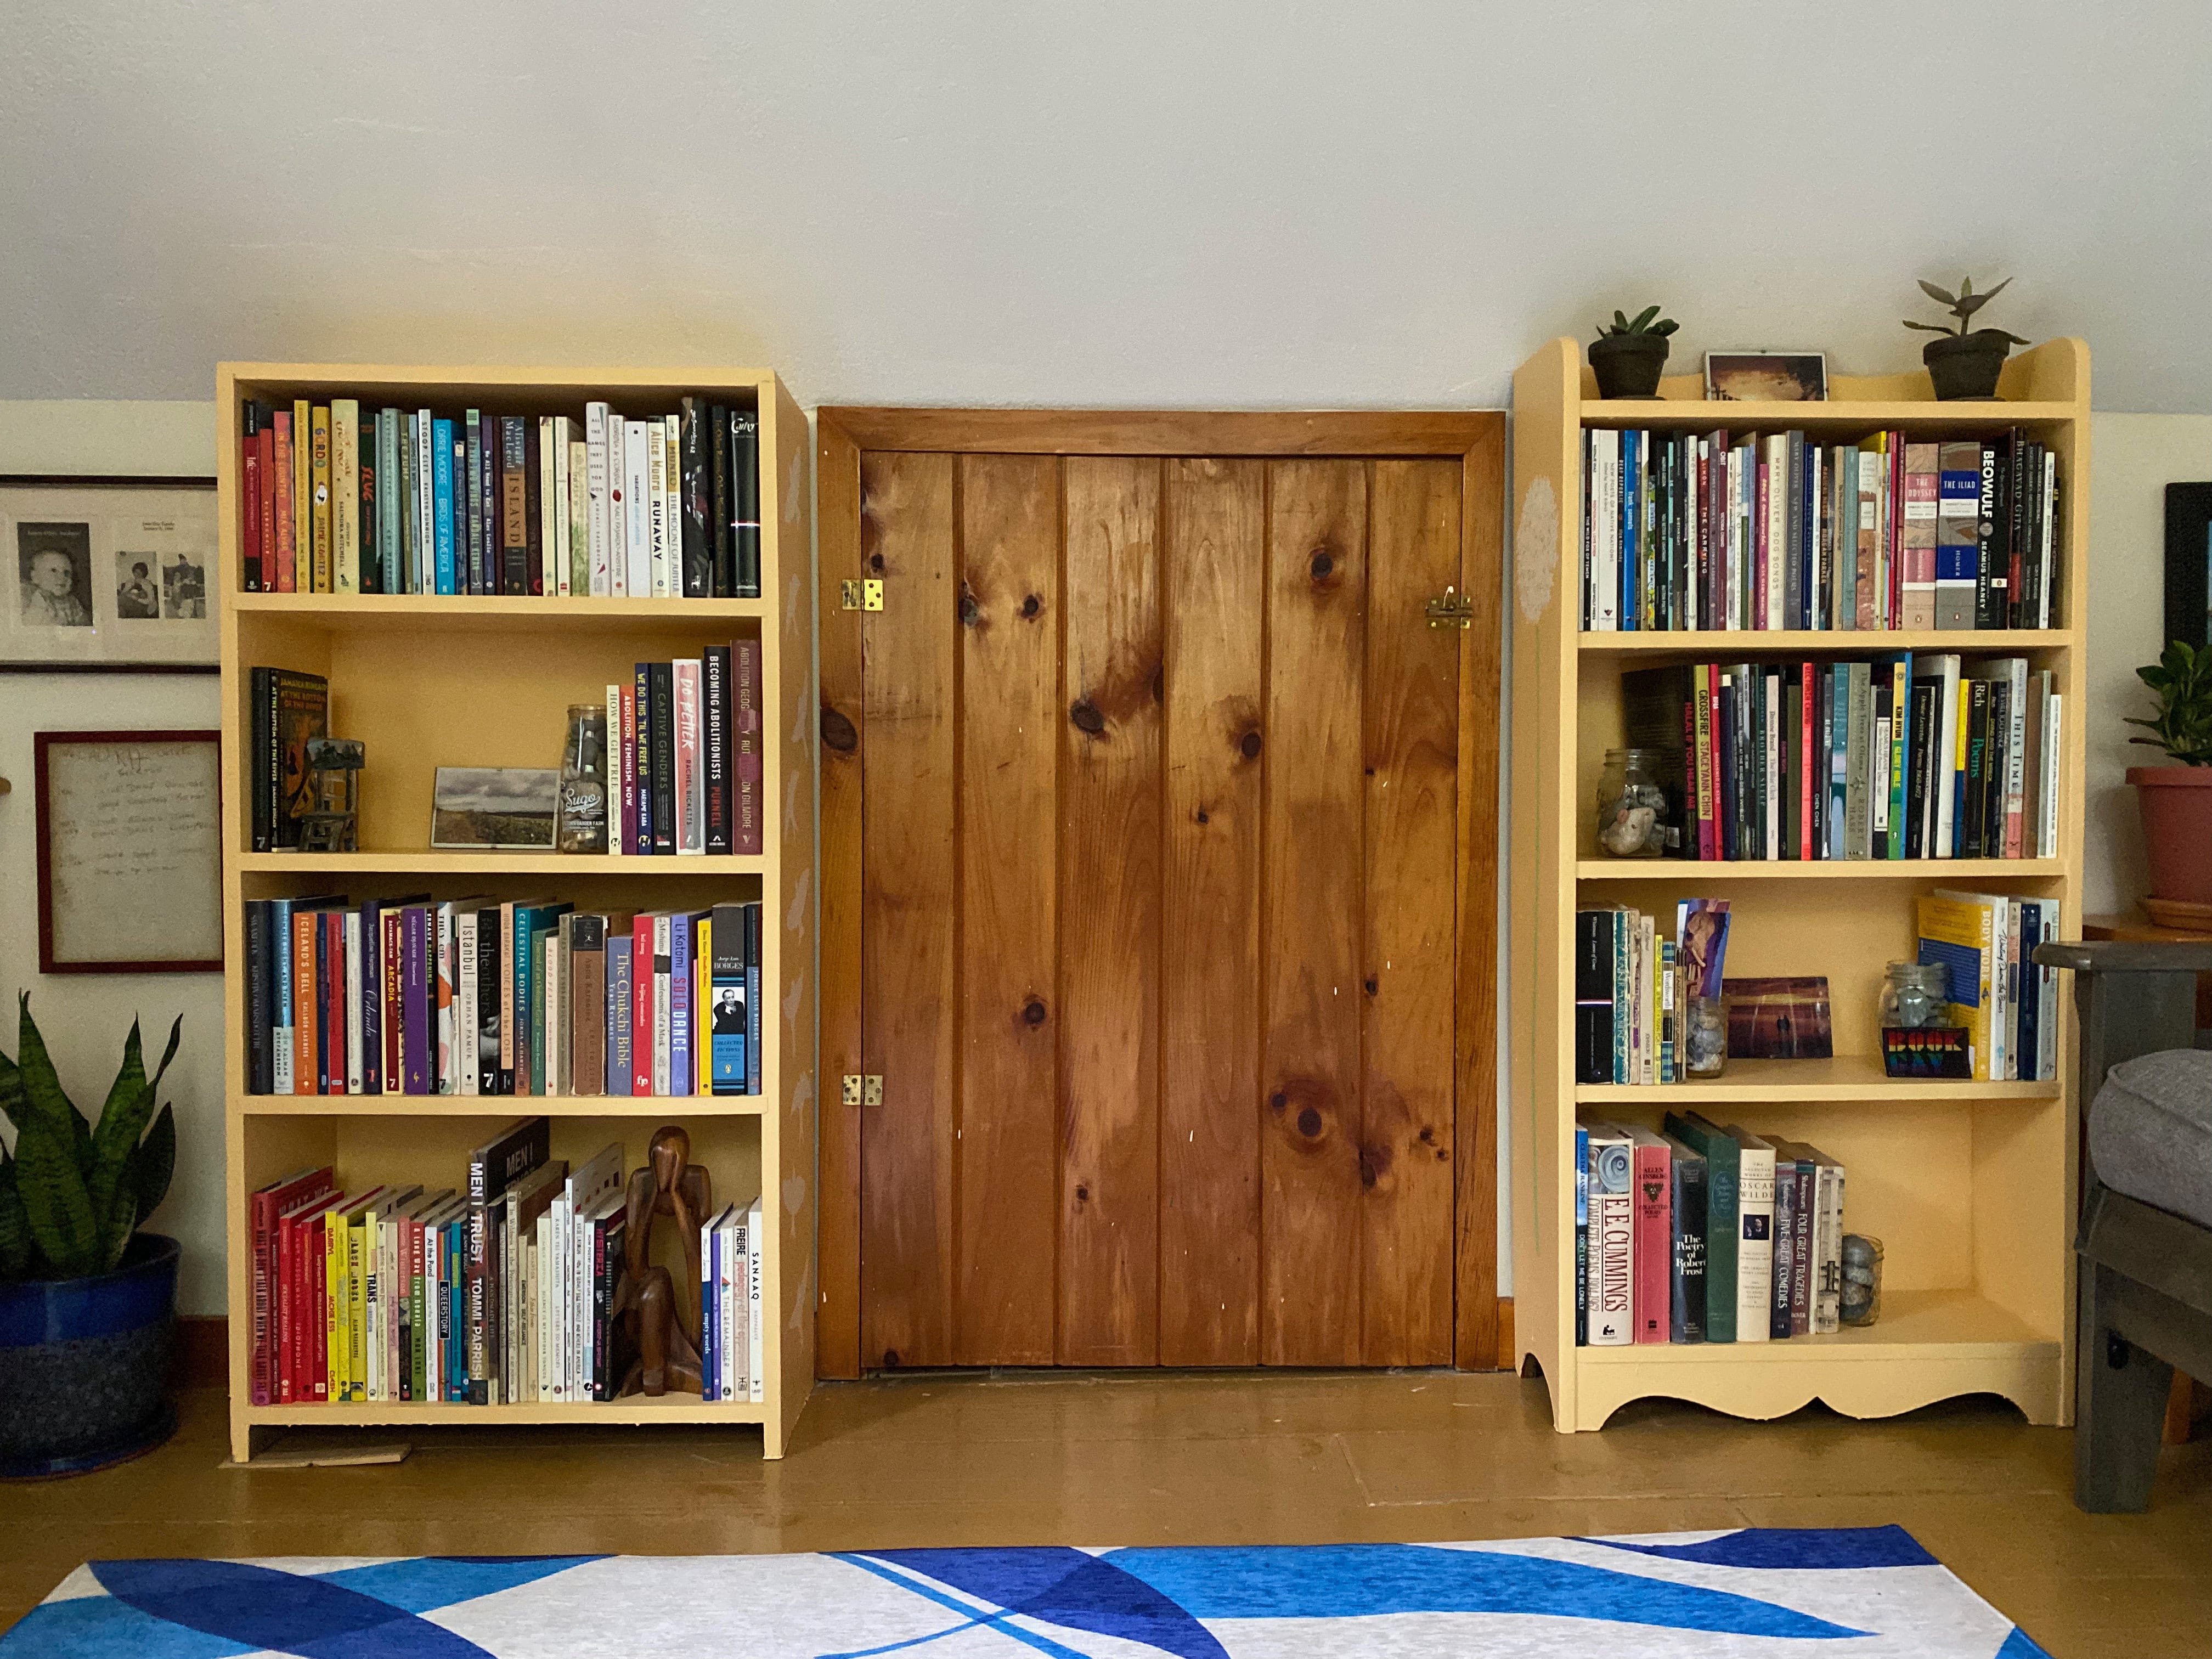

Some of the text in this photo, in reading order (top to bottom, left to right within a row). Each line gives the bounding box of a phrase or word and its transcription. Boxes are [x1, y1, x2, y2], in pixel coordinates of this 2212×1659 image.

[315, 428, 326, 468] GORDO
[437, 425, 447, 485] LORRIE MOORE
[506, 421, 514, 468] MacLeod
[515, 425, 523, 465] Alistair
[651, 431, 663, 491] Alice Munro
[362, 466, 374, 501] SLUG
[669, 447, 677, 486] MUNRO
[1981, 451, 1994, 518] BEOWULF
[2014, 441, 2024, 531] BHAGAVAD GITA
[509, 477, 520, 543] ISLAND
[1610, 500, 1615, 509] OF
[439, 498, 449, 572] BIRDS OF AMERICA
[653, 501, 662, 560] RUNAWAY
[672, 549, 678, 560] OF
[638, 674, 645, 684] WE
[638, 687, 645, 697] DO
[1974, 685, 1985, 707] Rich
[638, 700, 646, 716] THIS
[681, 679, 694, 750] DO BETTER
[709, 656, 720, 780] BECOMING ABOLITIONISTS
[1685, 702, 1694, 733] HALAL
[1699, 690, 1708, 736] CROSSFIRE
[611, 722, 618, 737] WE
[639, 734, 647, 744] WE
[1685, 735, 1694, 743] IF
[639, 747, 647, 763] FREE
[639, 766, 647, 775] US
[659, 741, 667, 789] GENDERS
[1685, 746, 1694, 765] YOU
[1972, 738, 1984, 778] Poems
[2012, 715, 2023, 788] THIS TIME
[1700, 742, 1711, 816] STACEYANN CHIN
[566, 788, 600, 813] Sugo
[711, 787, 721, 828] PURNELL
[742, 795, 751, 828] GILMORE
[1687, 795, 1695, 809] ME
[301, 918, 309, 994] ICELAND'S BELL
[463, 926, 475, 975] Istanbul
[675, 924, 686, 968] Li Kotomi
[1982, 910, 1991, 981] BODY WORK
[365, 990, 378, 1037] Orlanda
[617, 952, 629, 1068] The Chukchi Bible
[470, 1163, 483, 1197] MEN
[1740, 1190, 1775, 1199] WILDE
[471, 1214, 483, 1263] TRUST
[737, 1228, 746, 1255] FREIRE
[1605, 1198, 1629, 1312] E. E. CUMMINGS
[1677, 1242, 1705, 1251] Poetry
[1683, 1234, 1700, 1243] The
[1687, 1250, 1696, 1260] of
[1675, 1259, 1706, 1267] Robert
[1680, 1266, 1702, 1276] Frost
[1778, 1219, 1790, 1308] FIVE GREAT COMEDIES
[1795, 1214, 1807, 1306] FOUR GREAT TRAGEDIES
[367, 1273, 376, 1303] TRANS
[472, 1278, 483, 1380] TOMMI PARRISH
